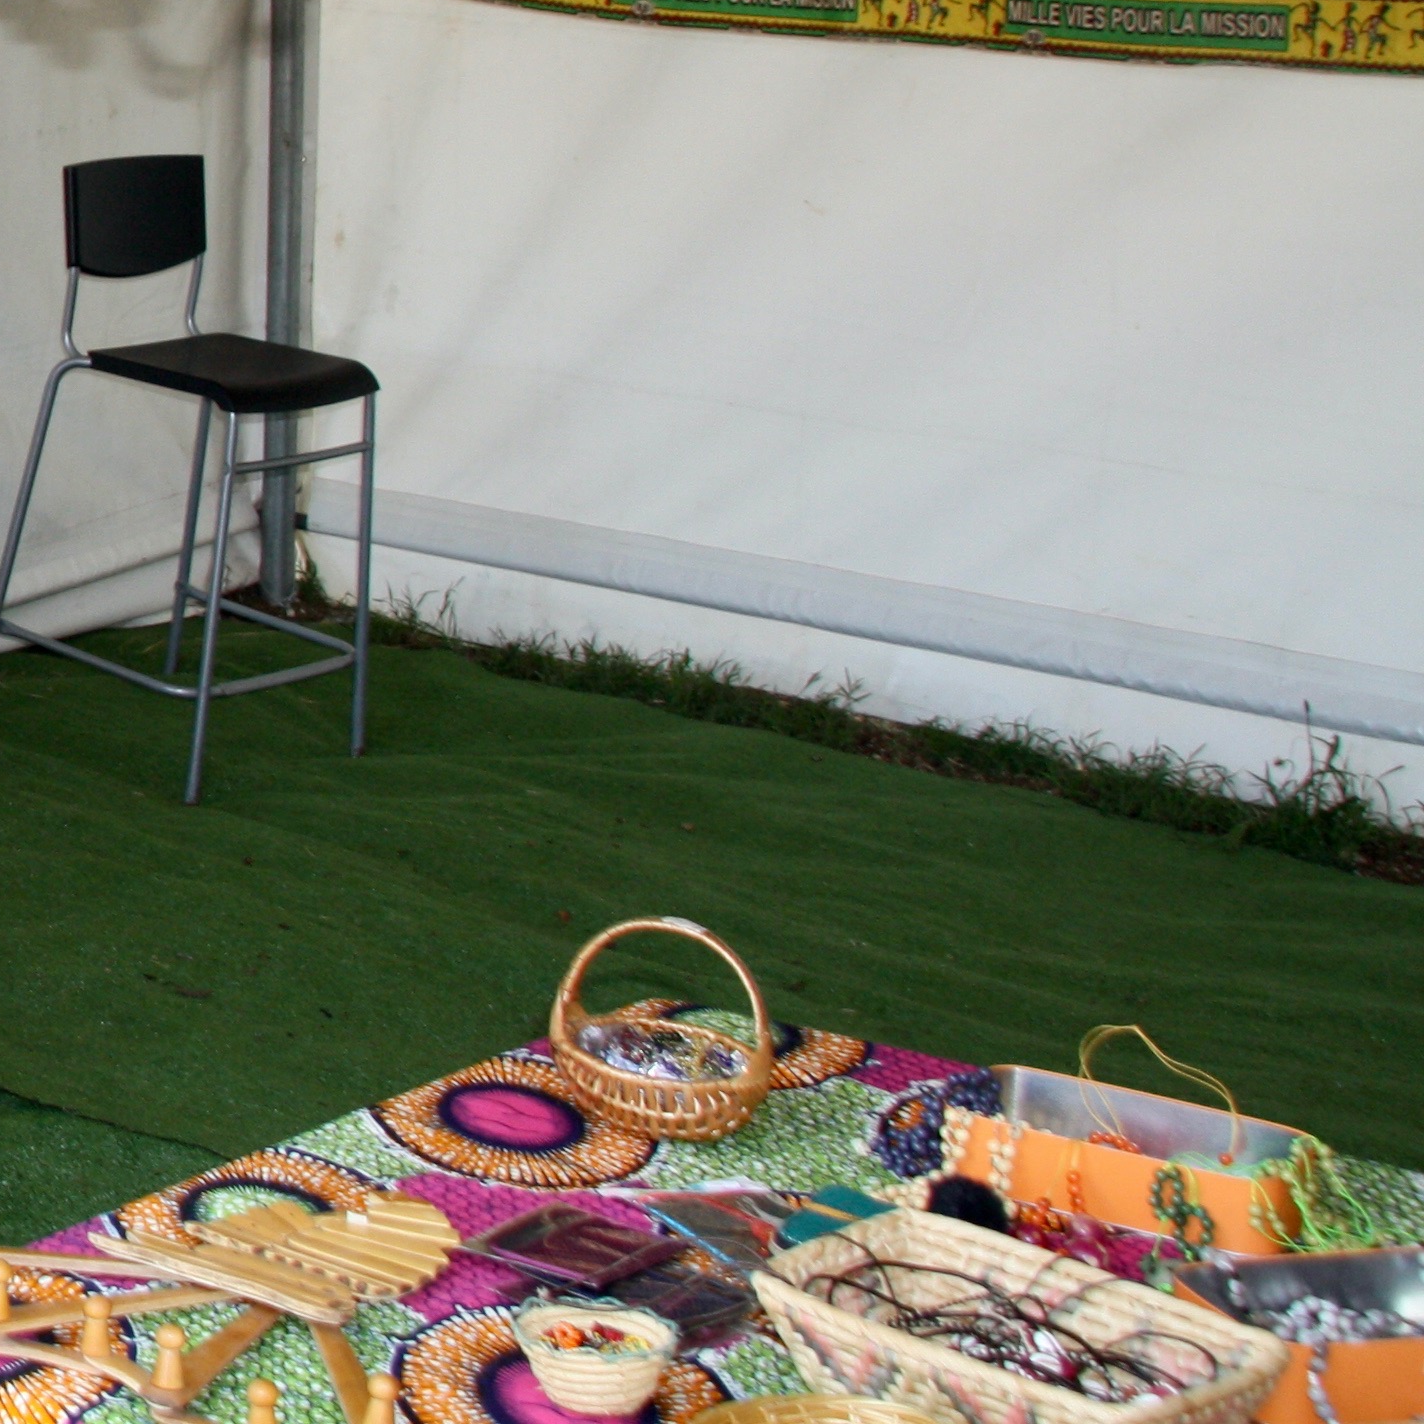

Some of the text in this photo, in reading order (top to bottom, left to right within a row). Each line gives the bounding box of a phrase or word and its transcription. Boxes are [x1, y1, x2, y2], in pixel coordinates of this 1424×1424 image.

[1008, 0, 1286, 39] MILLE VIES POUR LA MISSION
